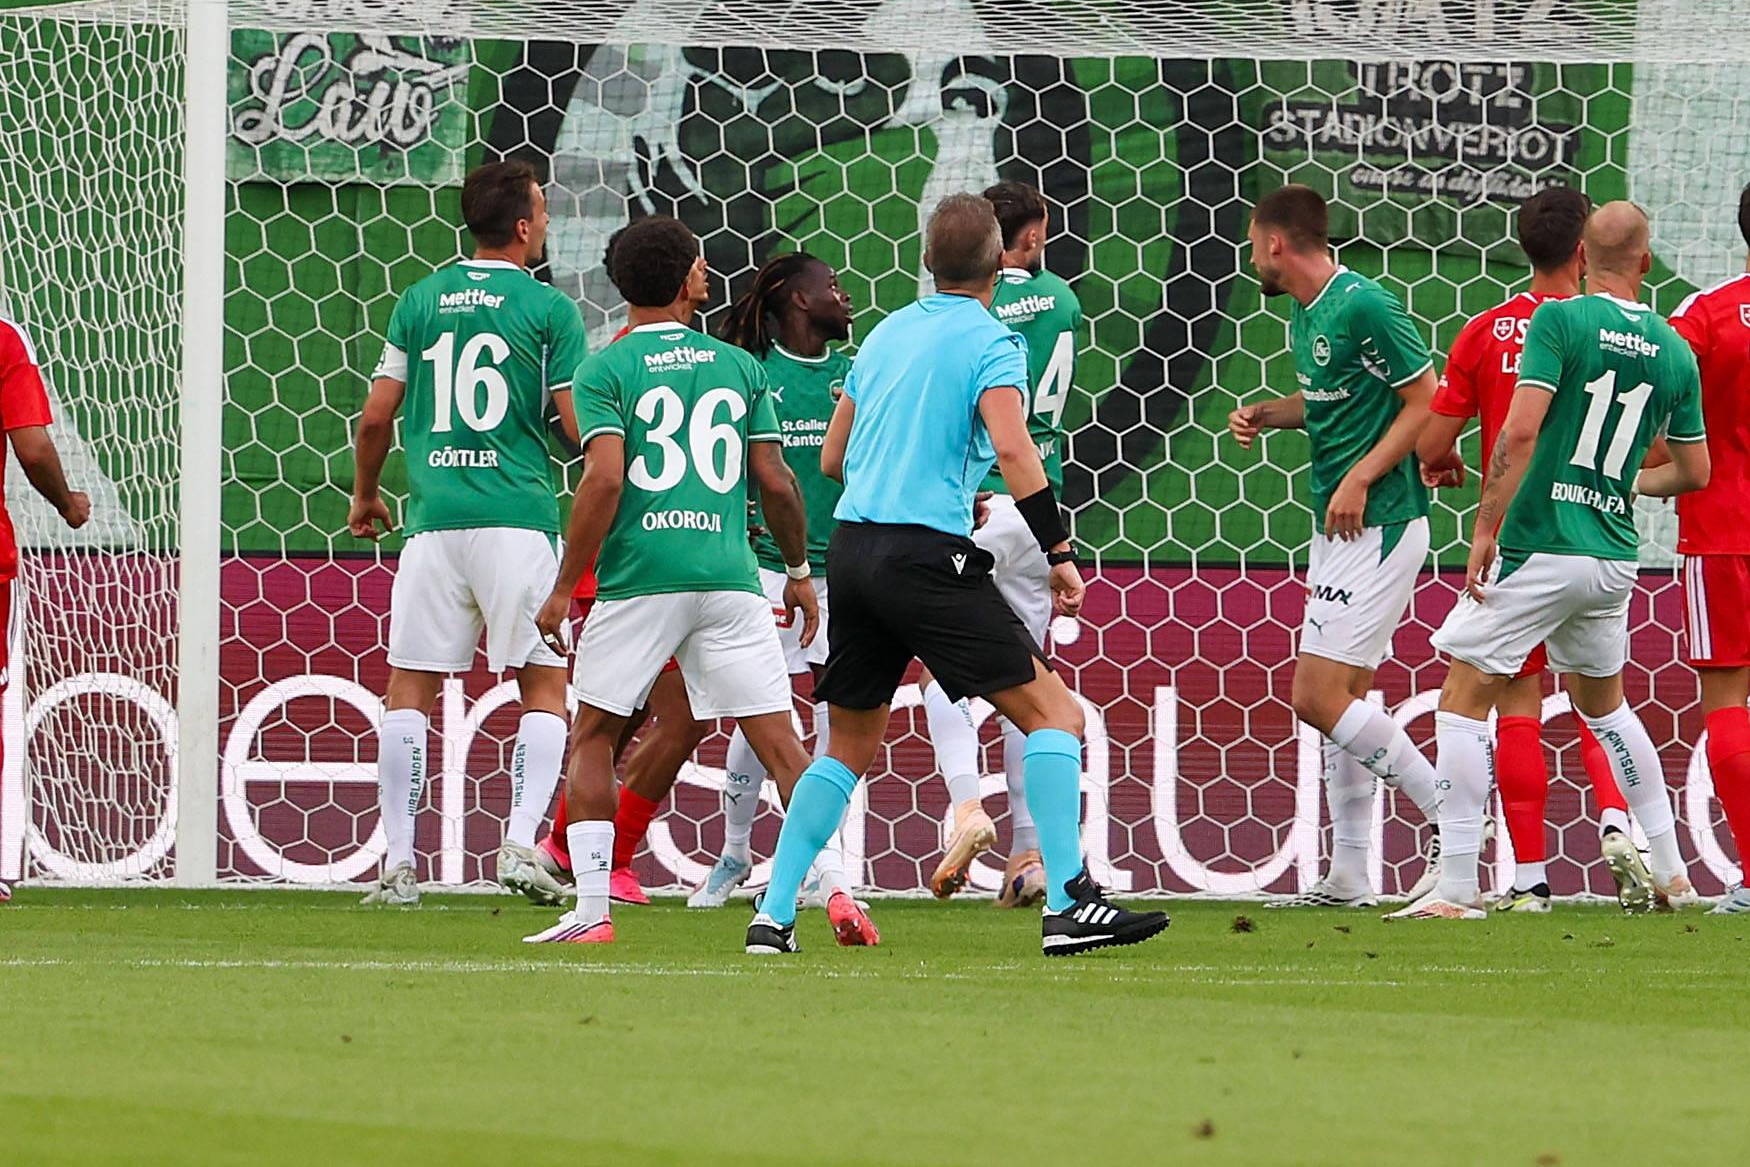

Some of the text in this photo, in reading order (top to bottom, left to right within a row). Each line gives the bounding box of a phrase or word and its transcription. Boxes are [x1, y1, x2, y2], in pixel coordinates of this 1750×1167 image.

[439, 288, 505, 309] Mettler
[995, 294, 1056, 318] Mettler
[644, 346, 716, 368] Mettler
[1600, 328, 1660, 359] Mettler
[423, 332, 511, 433] 16
[1022, 331, 1073, 429] 4
[628, 386, 747, 494] 36
[782, 434, 826, 448] Kanto
[1570, 369, 1653, 481] 11
[641, 510, 722, 533] OKOROJI
[407, 746, 422, 817] HIRSLANDEN
[514, 742, 527, 808] HIRSLANDEN
